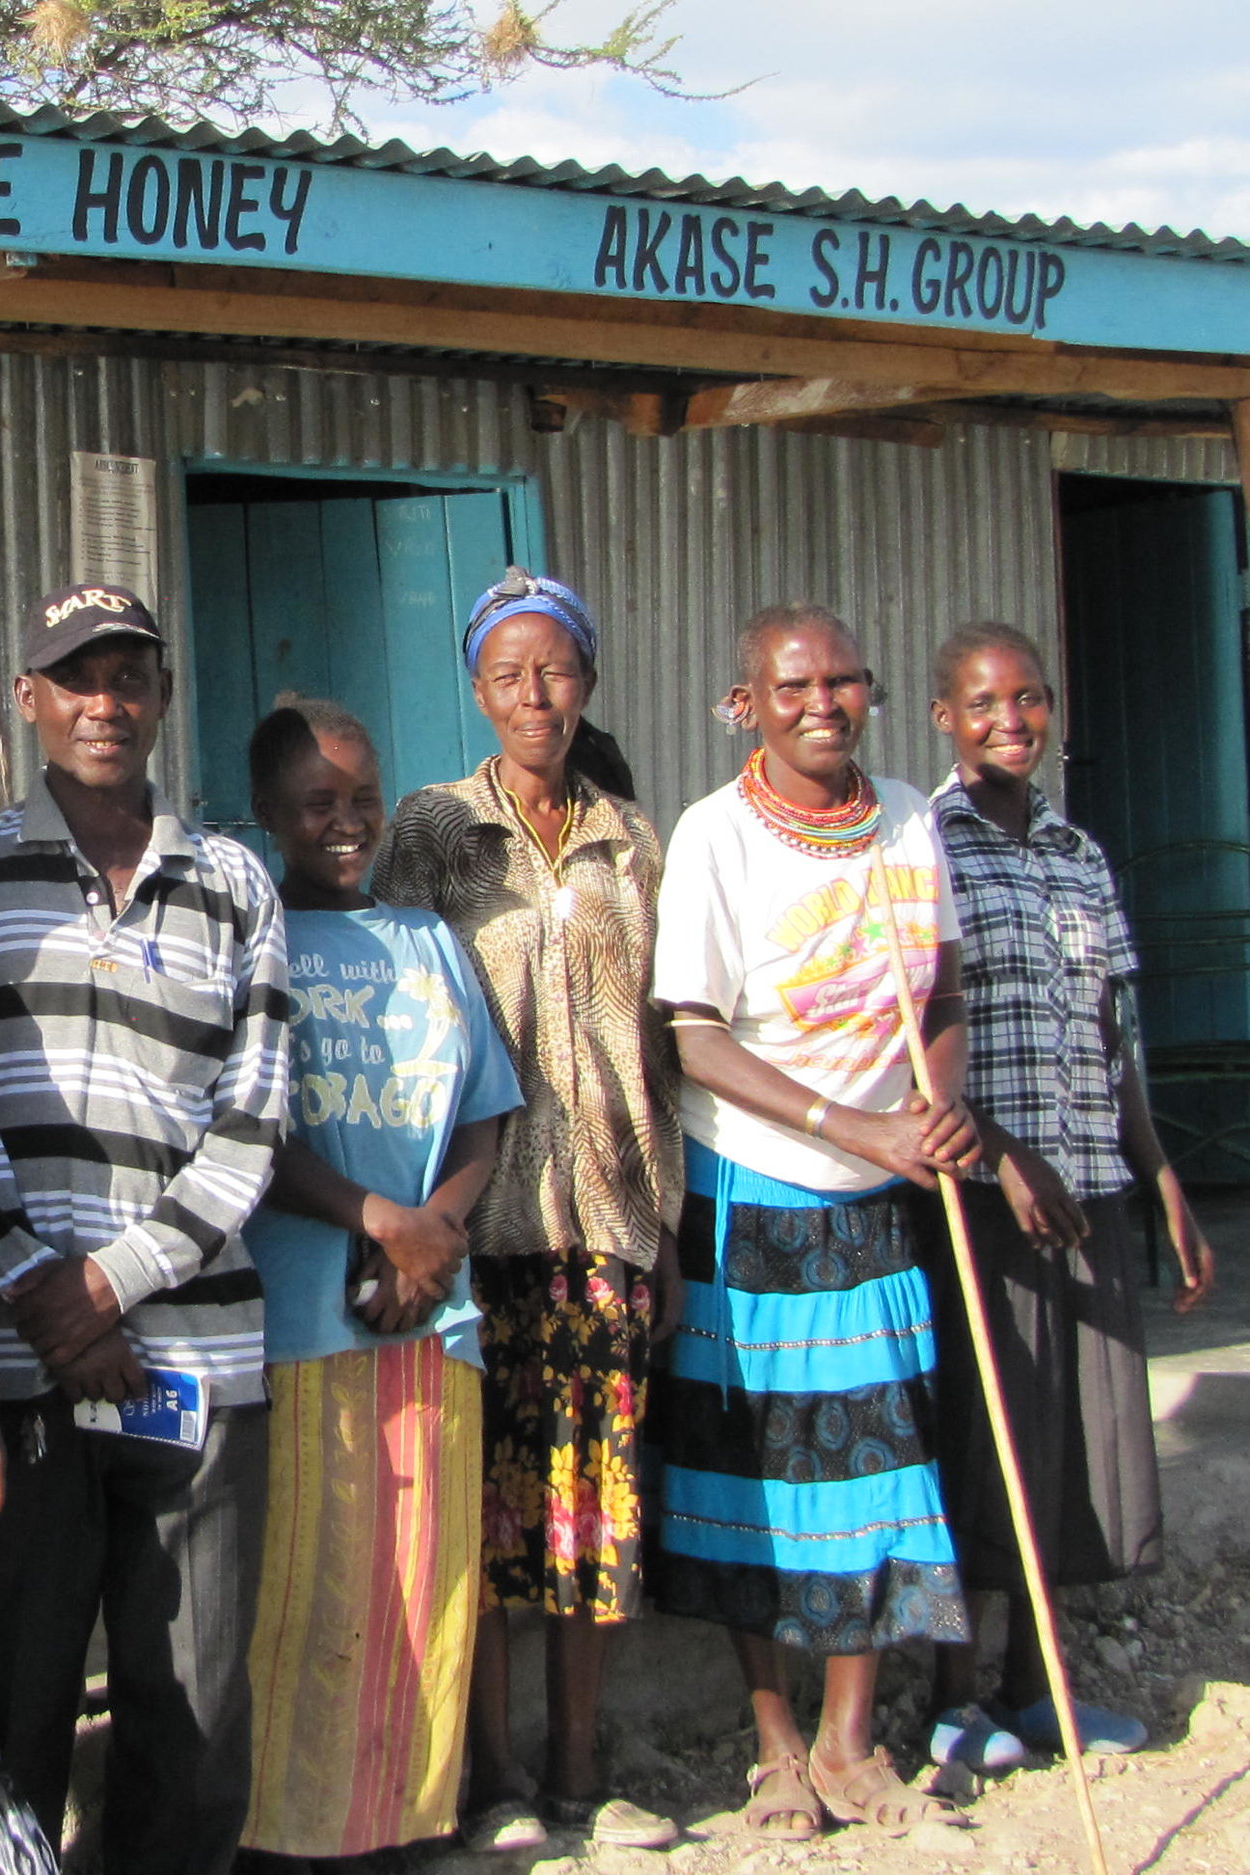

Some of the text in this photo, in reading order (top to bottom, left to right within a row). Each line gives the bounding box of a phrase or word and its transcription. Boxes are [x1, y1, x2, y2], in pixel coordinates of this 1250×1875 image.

[71, 148, 313, 255] HONEY
[594, 205, 776, 300] AKASE
[764, 877, 863, 955] WORLD
[339, 959, 398, 985] with
[164, 1389, 179, 1412] A6
